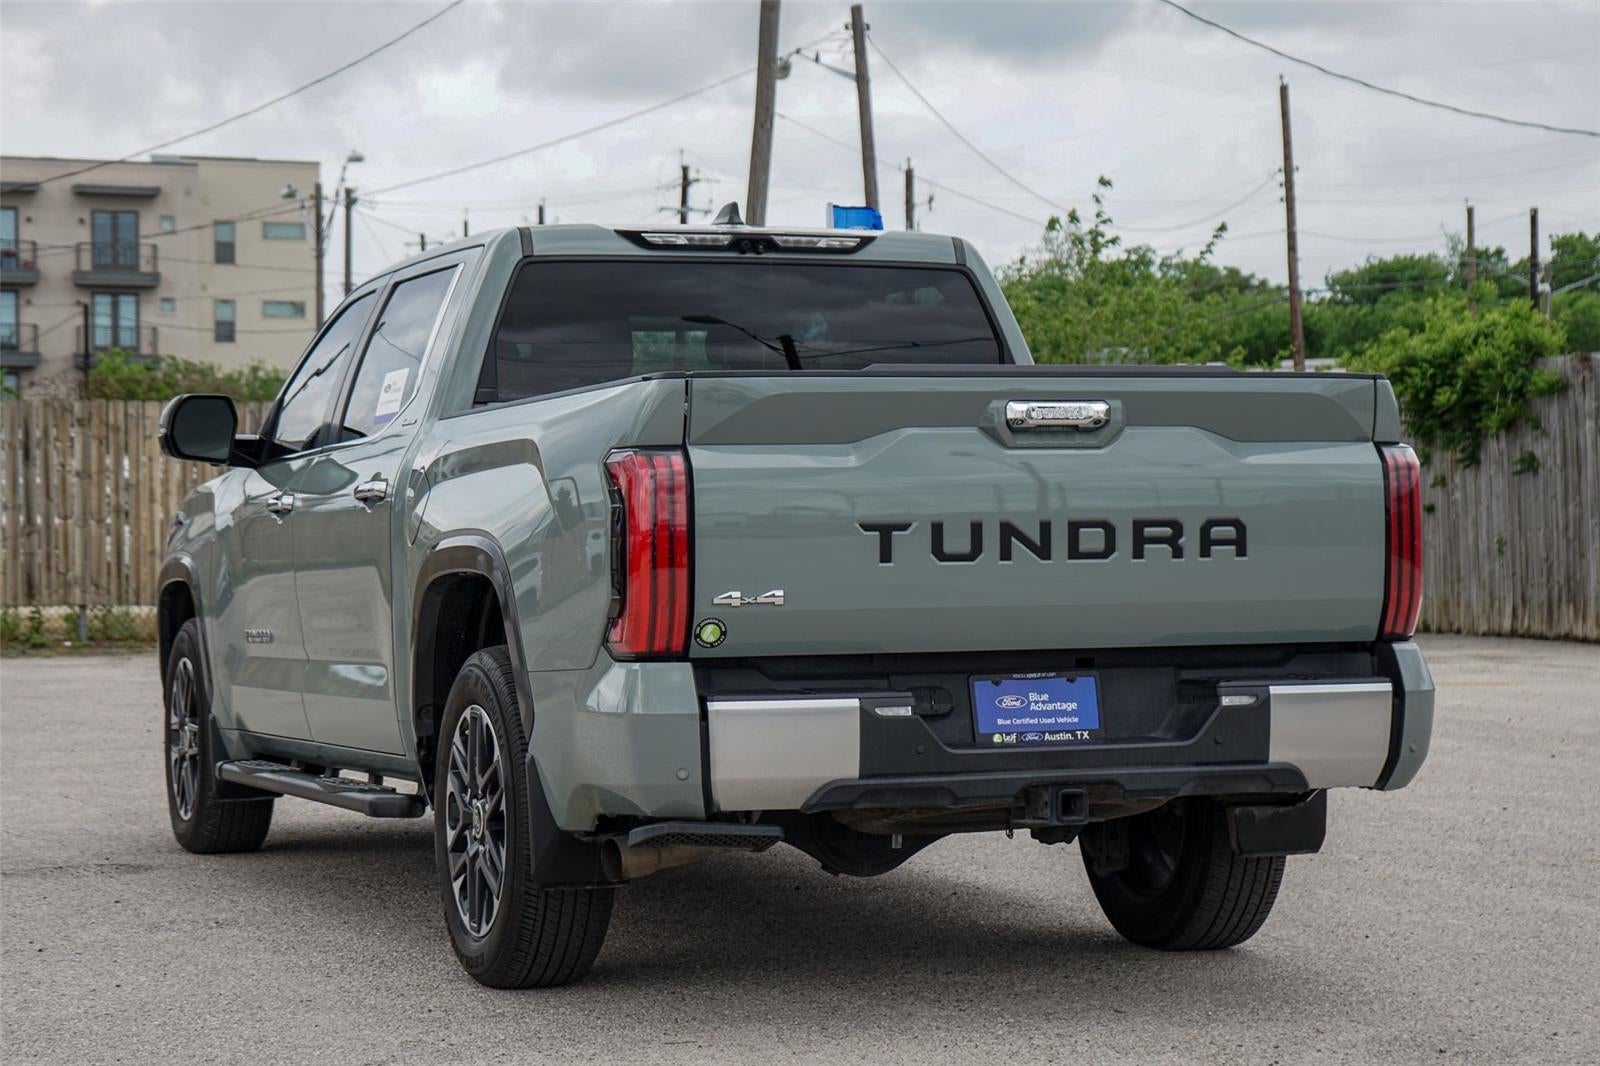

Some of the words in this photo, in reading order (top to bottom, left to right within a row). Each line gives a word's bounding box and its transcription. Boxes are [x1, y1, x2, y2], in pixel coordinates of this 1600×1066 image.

[855, 517, 1249, 566] TUNDRA
[712, 589, 785, 607] 4x4
[1028, 692, 1049, 701] Blue
[1000, 696, 1023, 708] Ford
[1030, 702, 1077, 712] Advantage
[997, 718, 1012, 726] Blue
[1012, 716, 1039, 725] Certified
[1039, 716, 1056, 724] Used
[1057, 716, 1079, 724] Vehicle
[1076, 731, 1090, 740] TX
